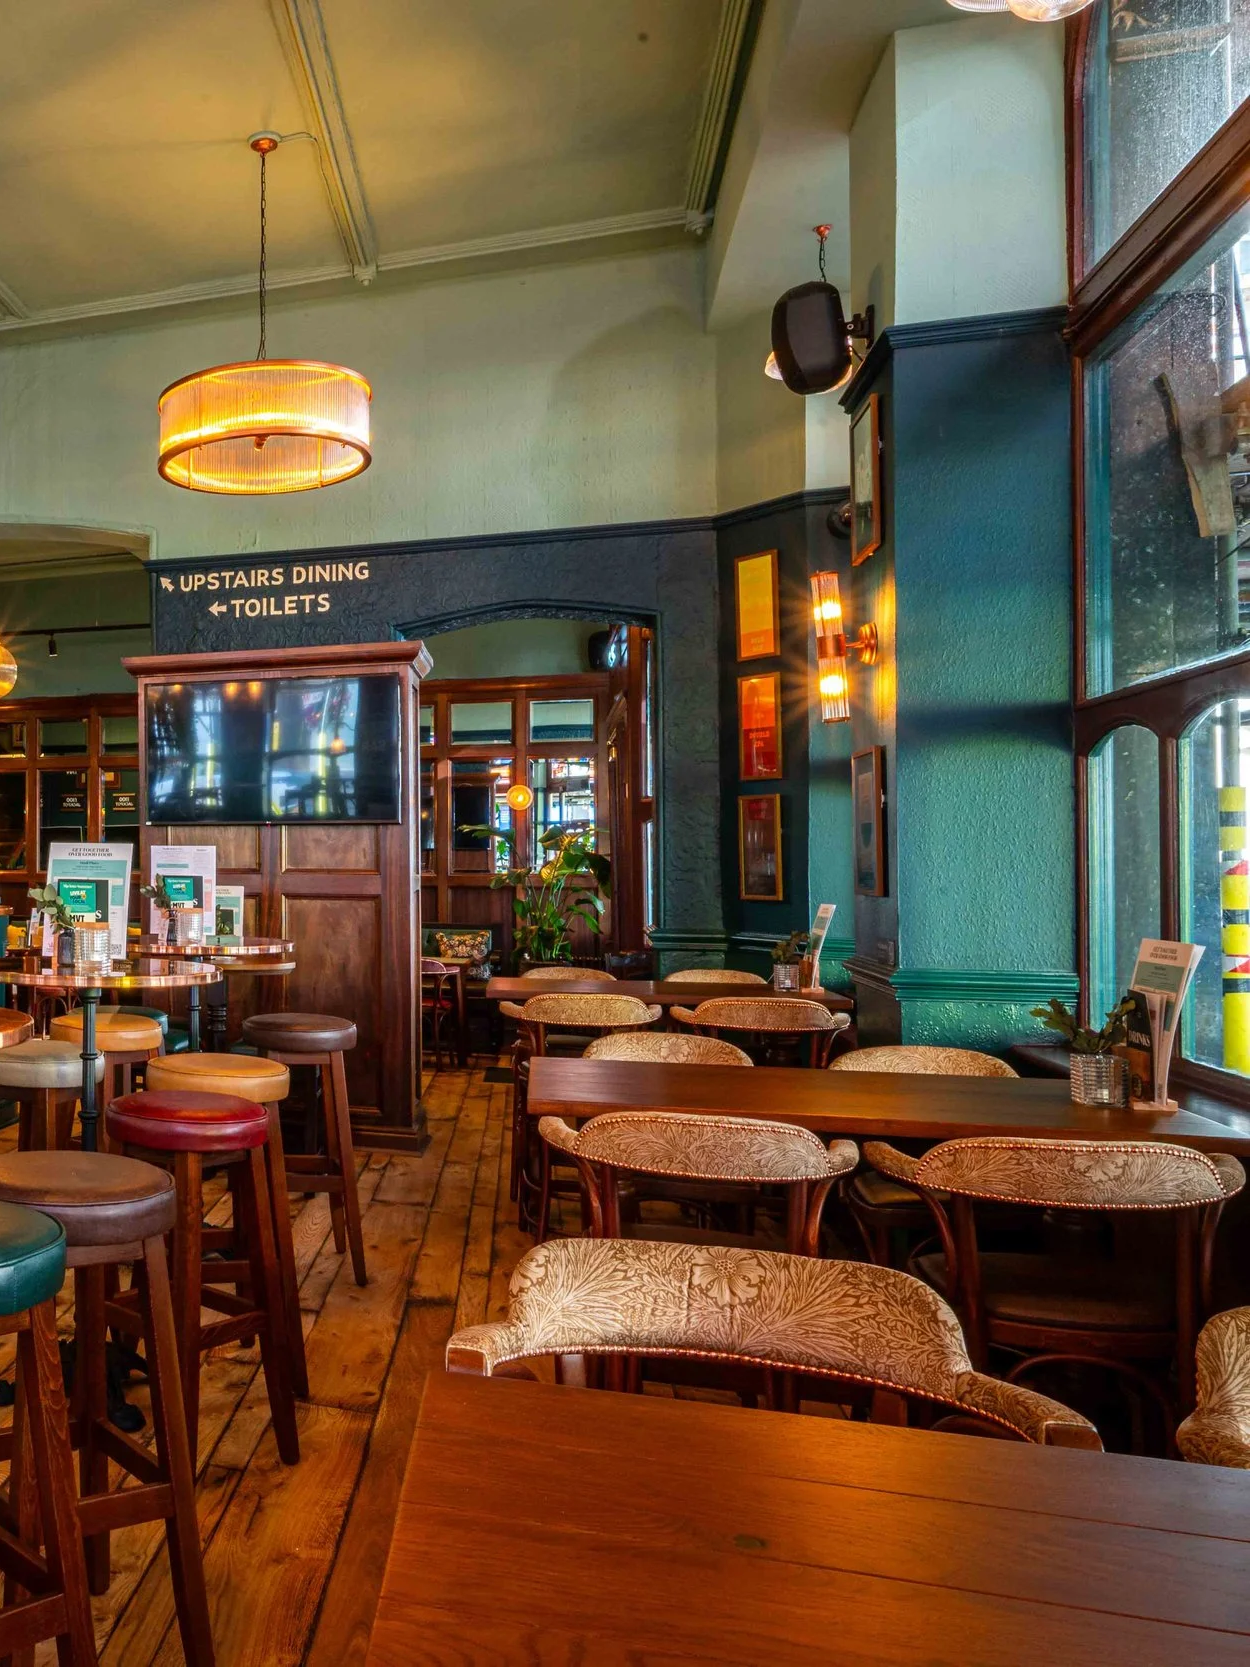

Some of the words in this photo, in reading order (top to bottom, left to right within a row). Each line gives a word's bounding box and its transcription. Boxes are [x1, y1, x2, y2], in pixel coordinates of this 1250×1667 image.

[180, 568, 284, 592] UPSTAIRS
[292, 562, 369, 585] DINING
[231, 593, 330, 618] TOILETS
